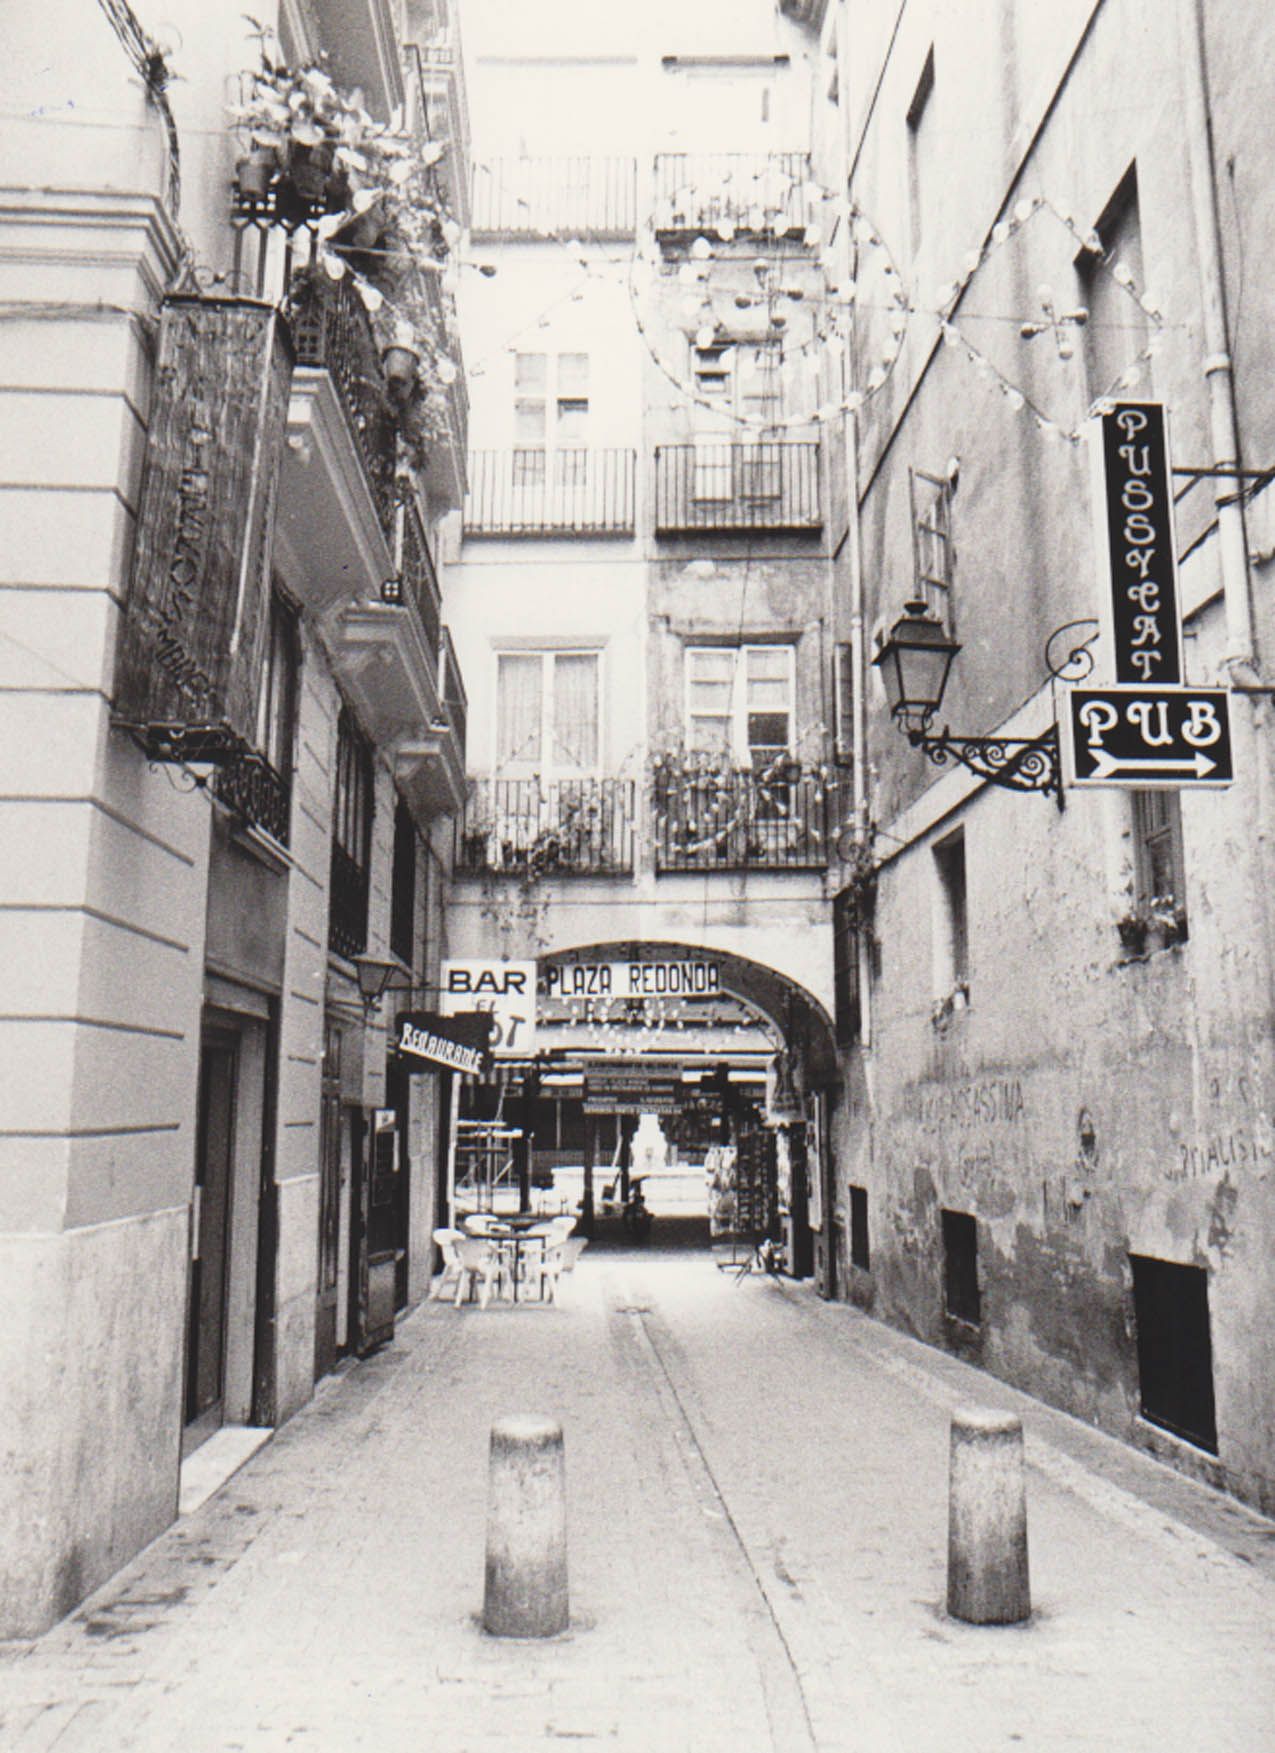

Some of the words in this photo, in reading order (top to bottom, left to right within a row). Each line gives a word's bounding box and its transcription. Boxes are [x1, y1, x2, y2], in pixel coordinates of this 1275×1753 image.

[1116, 408, 1163, 683] PUSSYCAT
[1079, 699, 1222, 748] PUB
[448, 969, 527, 995] BAR
[547, 964, 612, 996] PLAZA
[628, 962, 720, 994] REDONDA
